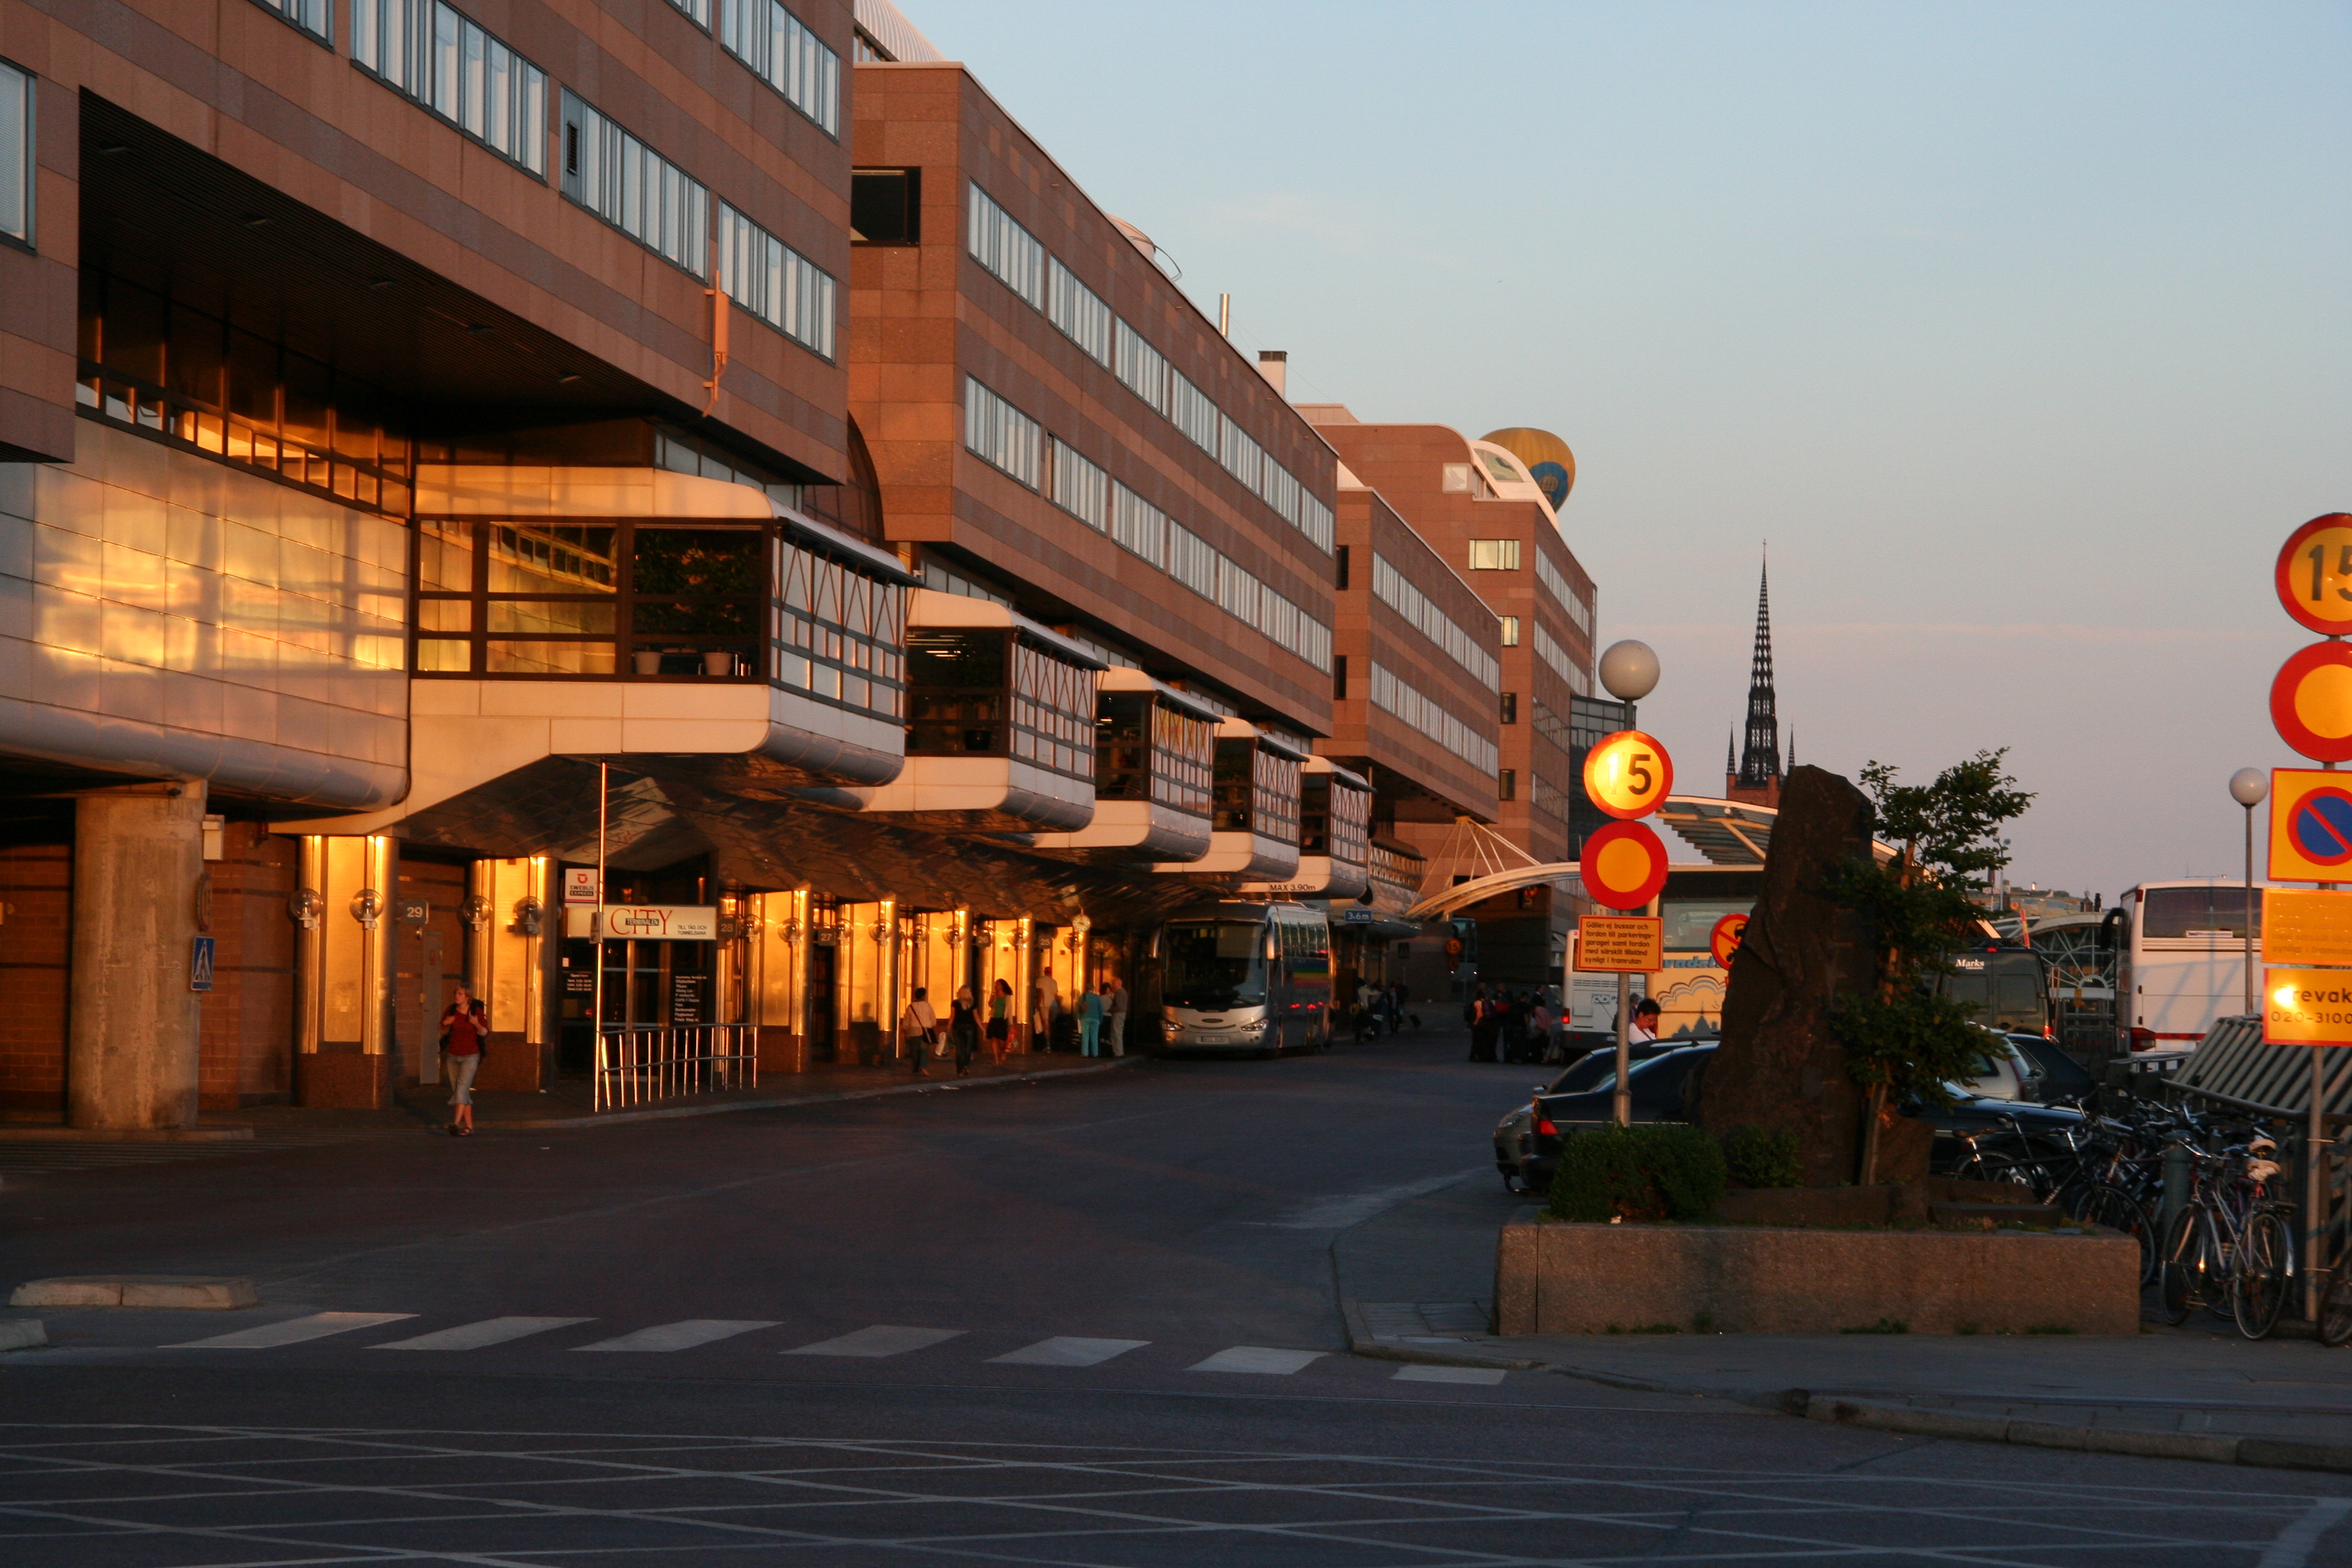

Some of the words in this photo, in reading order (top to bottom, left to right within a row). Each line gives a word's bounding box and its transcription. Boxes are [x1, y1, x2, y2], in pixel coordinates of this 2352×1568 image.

[1606, 752, 1652, 796] 15
[406, 906, 423, 917] 29
[610, 908, 673, 935] CITY
[721, 923, 733, 932] 28
[820, 932, 832, 941] 27
[978, 936, 988, 944] 26
[1448, 942, 1458, 951] 15
[1955, 958, 1984, 967] Marks
